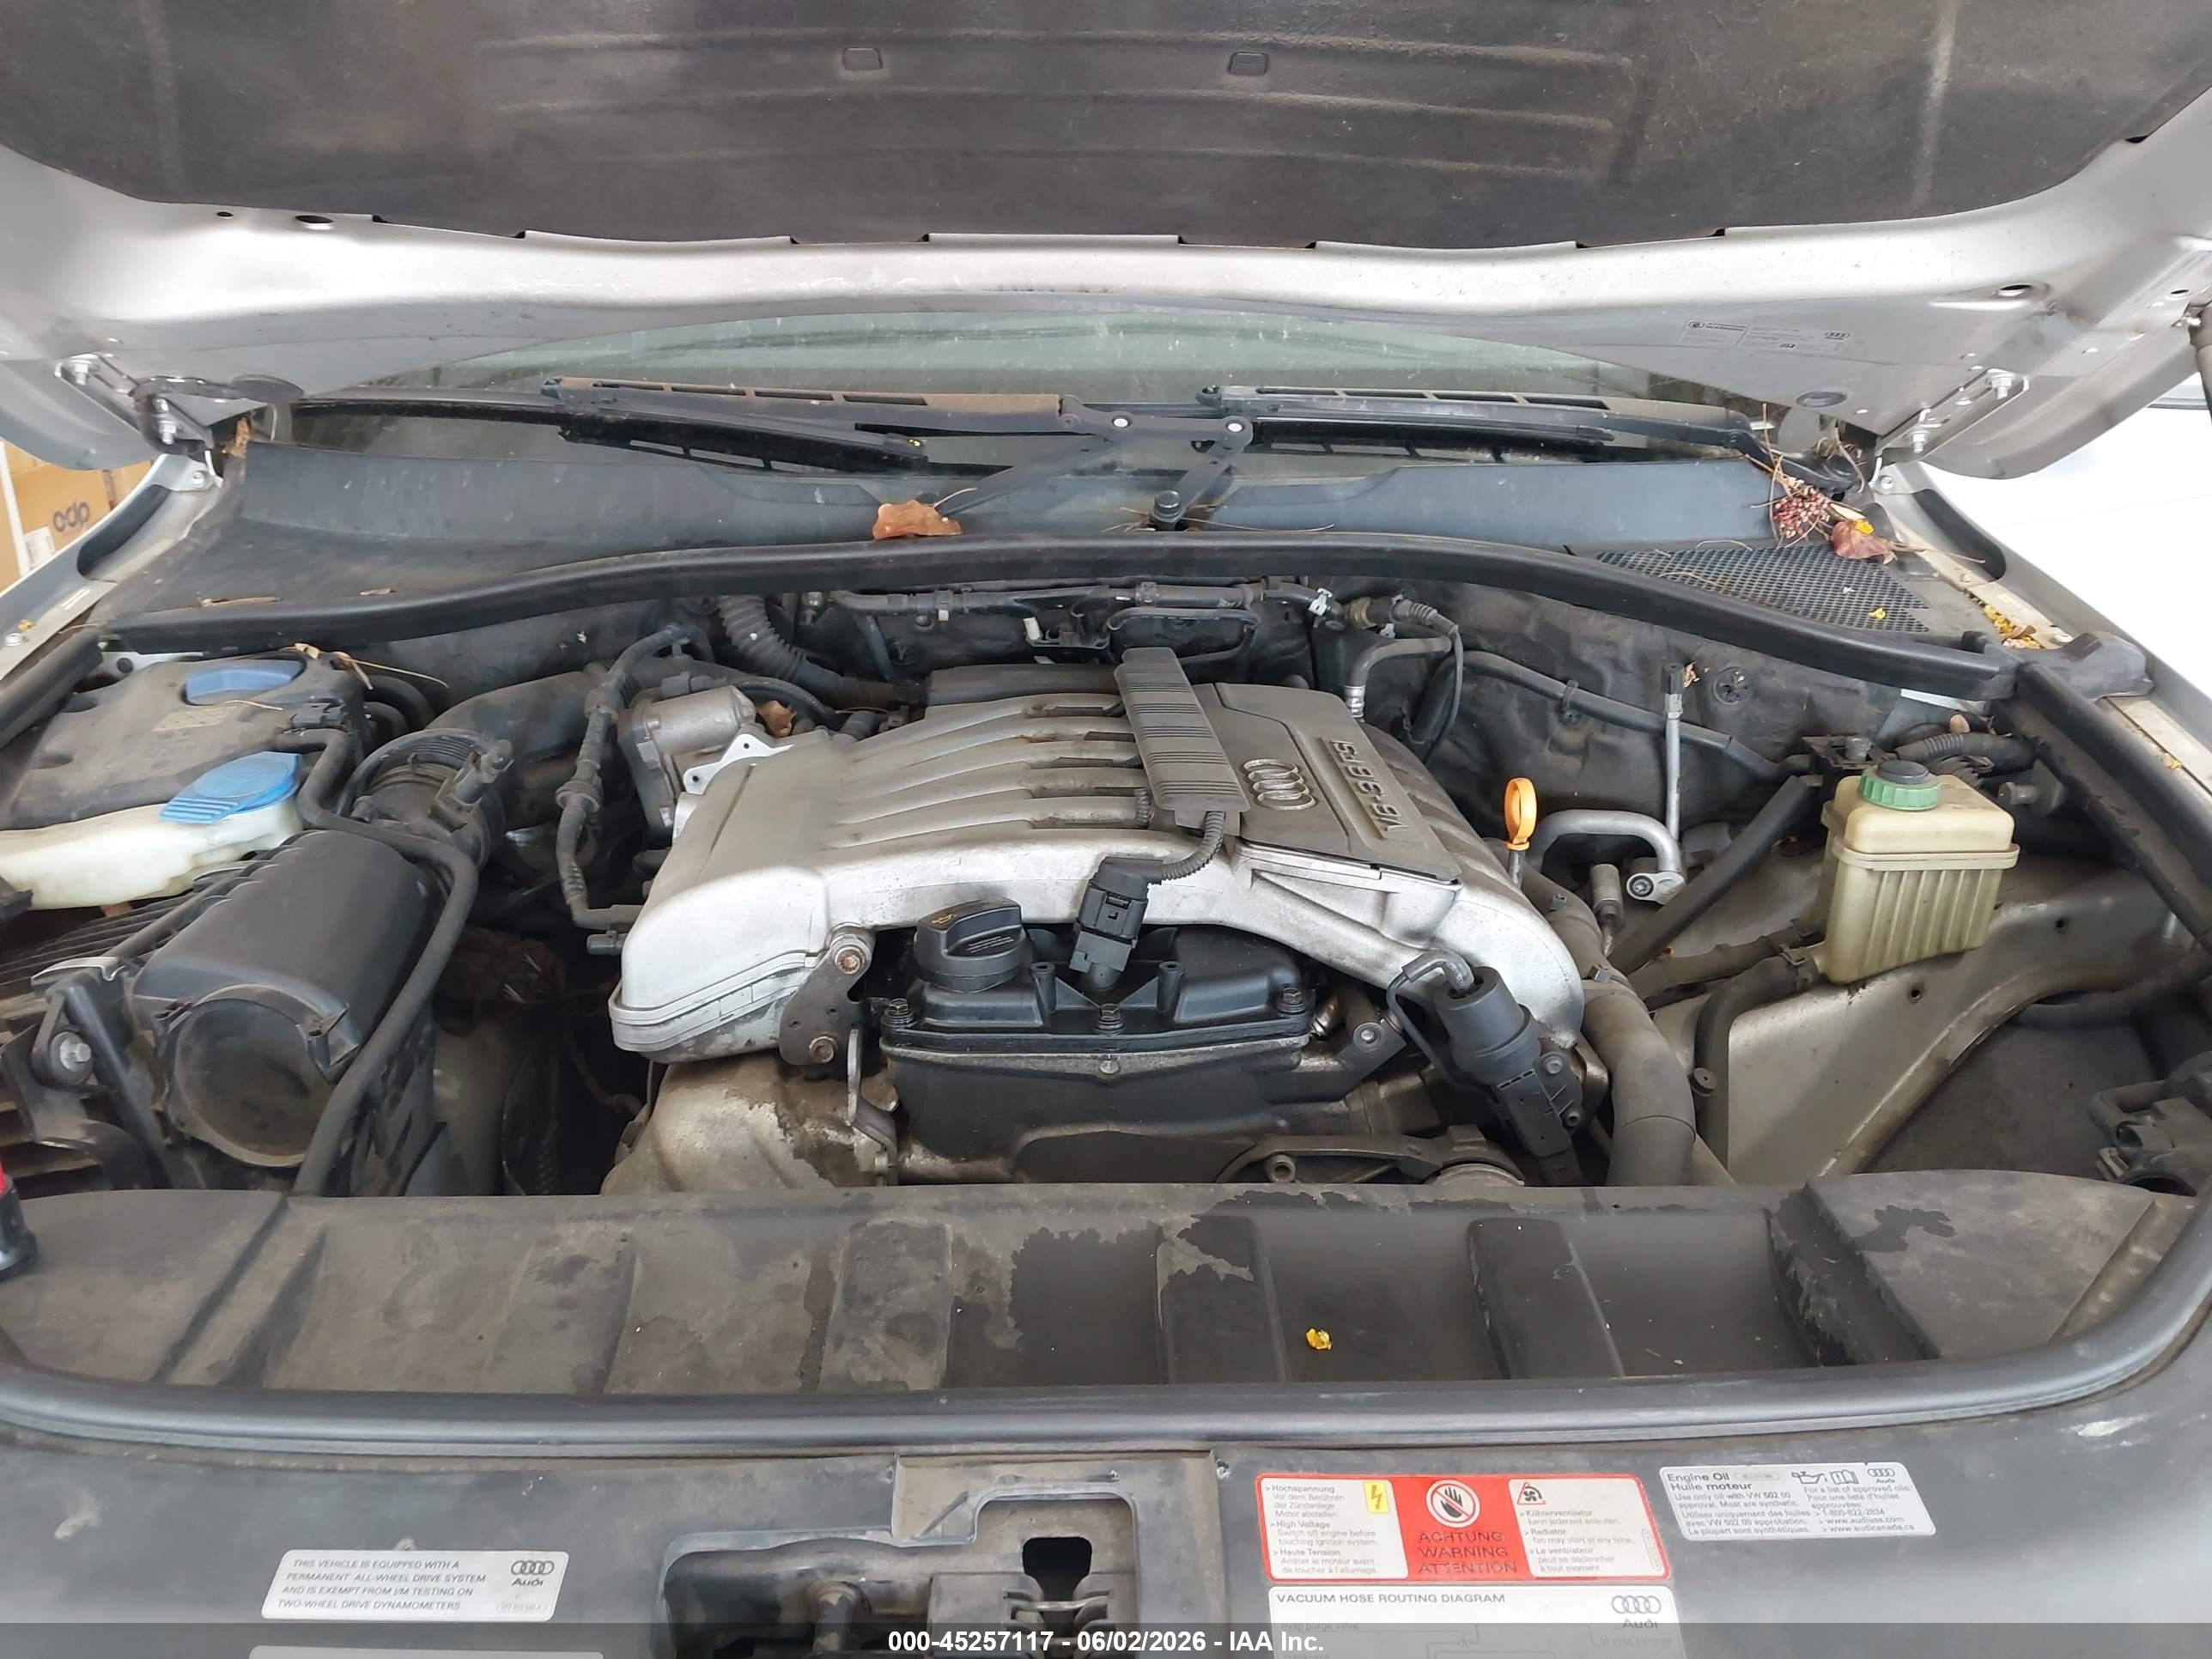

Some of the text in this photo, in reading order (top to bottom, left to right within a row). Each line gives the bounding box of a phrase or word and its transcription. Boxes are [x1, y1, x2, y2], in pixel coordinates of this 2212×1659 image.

[1668, 1474, 1709, 1484] Engine
[1712, 1472, 1729, 1481] Oil
[1272, 1484, 1335, 1493] Hochspannung
[1670, 1482, 1753, 1492] Huile moteur
[1853, 1485, 1893, 1493] approved
[1693, 1493, 1711, 1502] only
[1277, 1520, 1330, 1530] High Voltage
[1418, 1530, 1504, 1544] ACHTUNG
[1279, 1538, 1314, 1547] touching
[1315, 1538, 1345, 1547] ignition
[1279, 1548, 1341, 1557] Haute Tension
[1418, 1546, 1509, 1559] WARNING
[294, 1559, 459, 1569] THIS VEHICLE IS EQUIPPED WITH A
[1418, 1560, 1517, 1574] ATTENTION
[287, 1572, 487, 1583] PERMANENT ALL-WHEEL DRIVE SYSTEM
[511, 1578, 544, 1587] Audi
[282, 1586, 473, 1596] AND IS EXEMPT FROM I/M TESTING ON
[1277, 1593, 1505, 1603] VACUUM HOSE ROUTING DIAGRAM
[278, 1599, 461, 1610] TWO-WHEEL DRIVE DYNAMOMETERS
[1622, 1618, 1659, 1629] Audi
